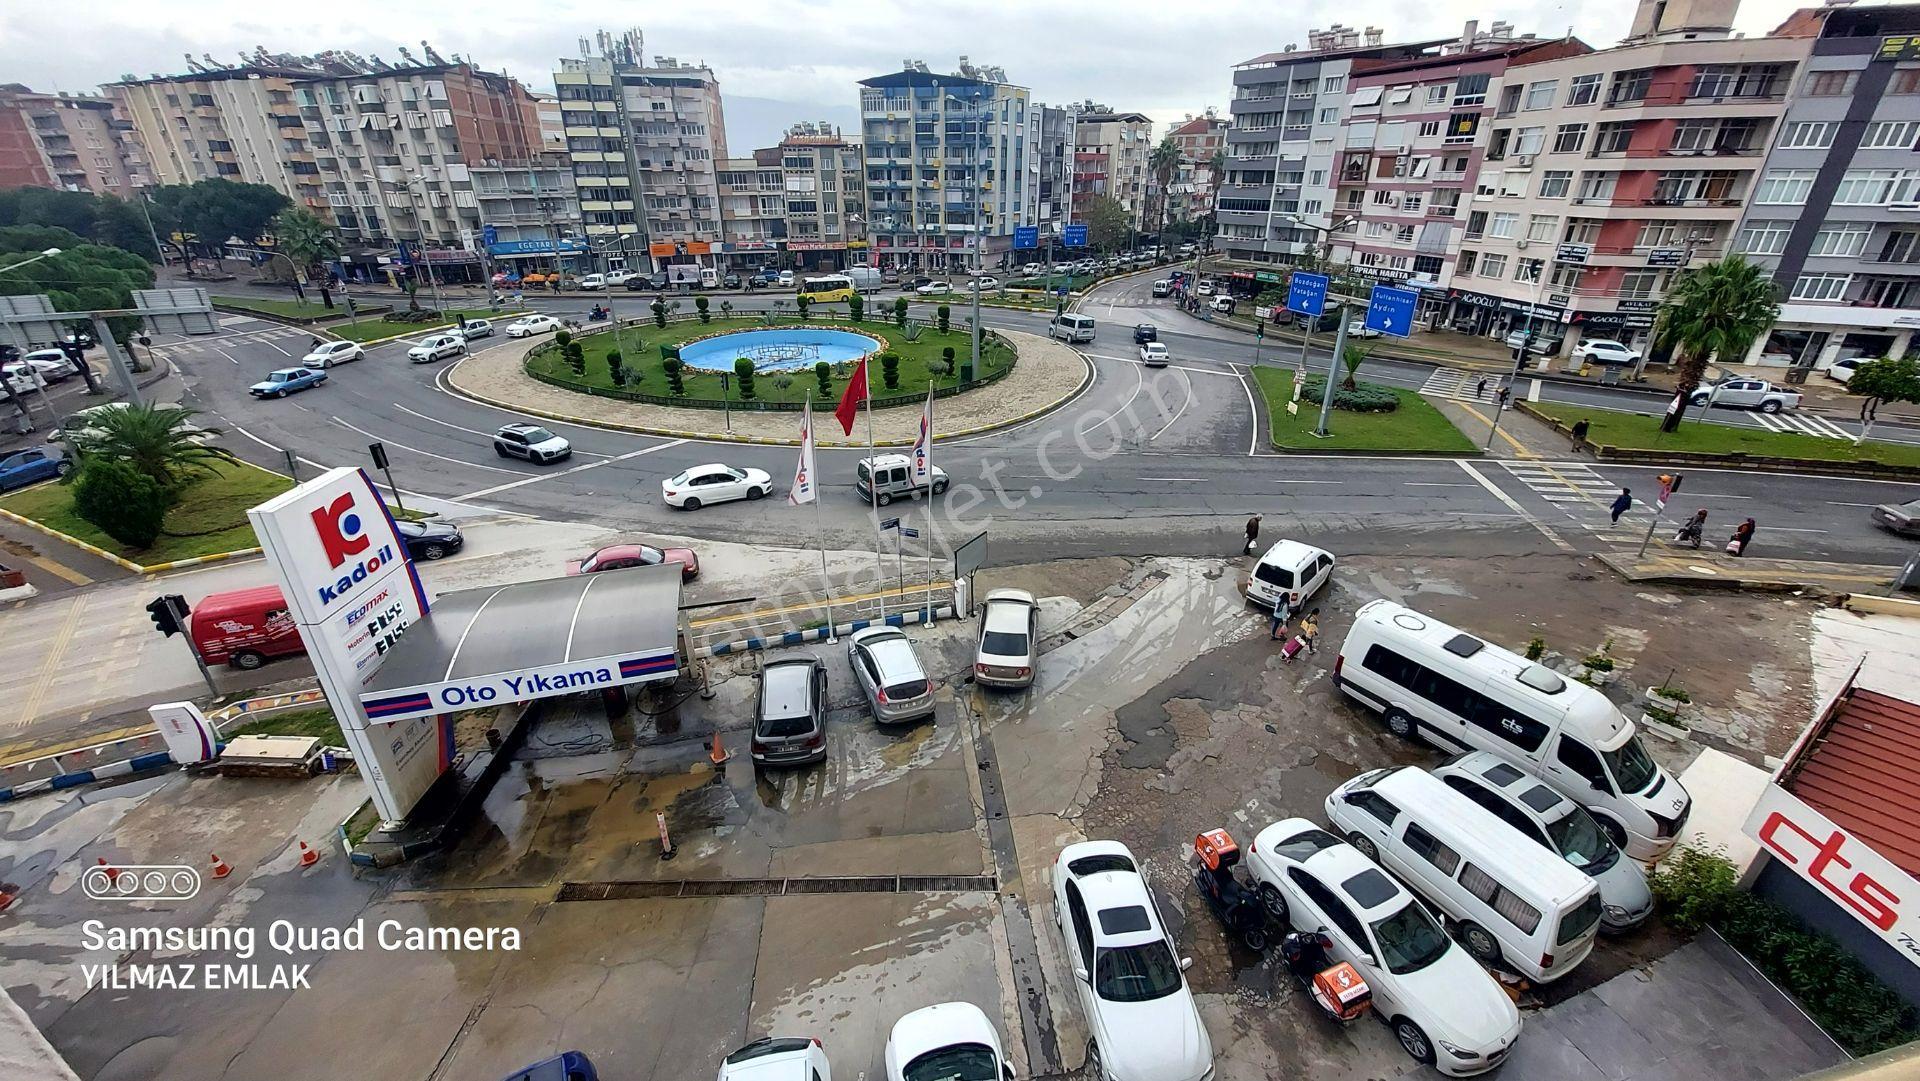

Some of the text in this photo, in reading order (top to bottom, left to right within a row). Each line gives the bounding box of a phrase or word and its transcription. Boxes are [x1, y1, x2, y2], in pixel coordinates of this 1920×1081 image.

[1379, 269, 1408, 279] HARİTA
[1375, 292, 1413, 305] Sultanhisar
[1461, 293, 1496, 308] AĞAOĞLU
[1373, 303, 1395, 313] Aydın
[318, 544, 393, 605] kadoil
[347, 631, 370, 651] Motorin
[441, 666, 612, 706] Oto Yıkama
[1502, 718, 1523, 733] cts
[1672, 798, 1684, 811] cts
[1758, 811, 1901, 932] cts
